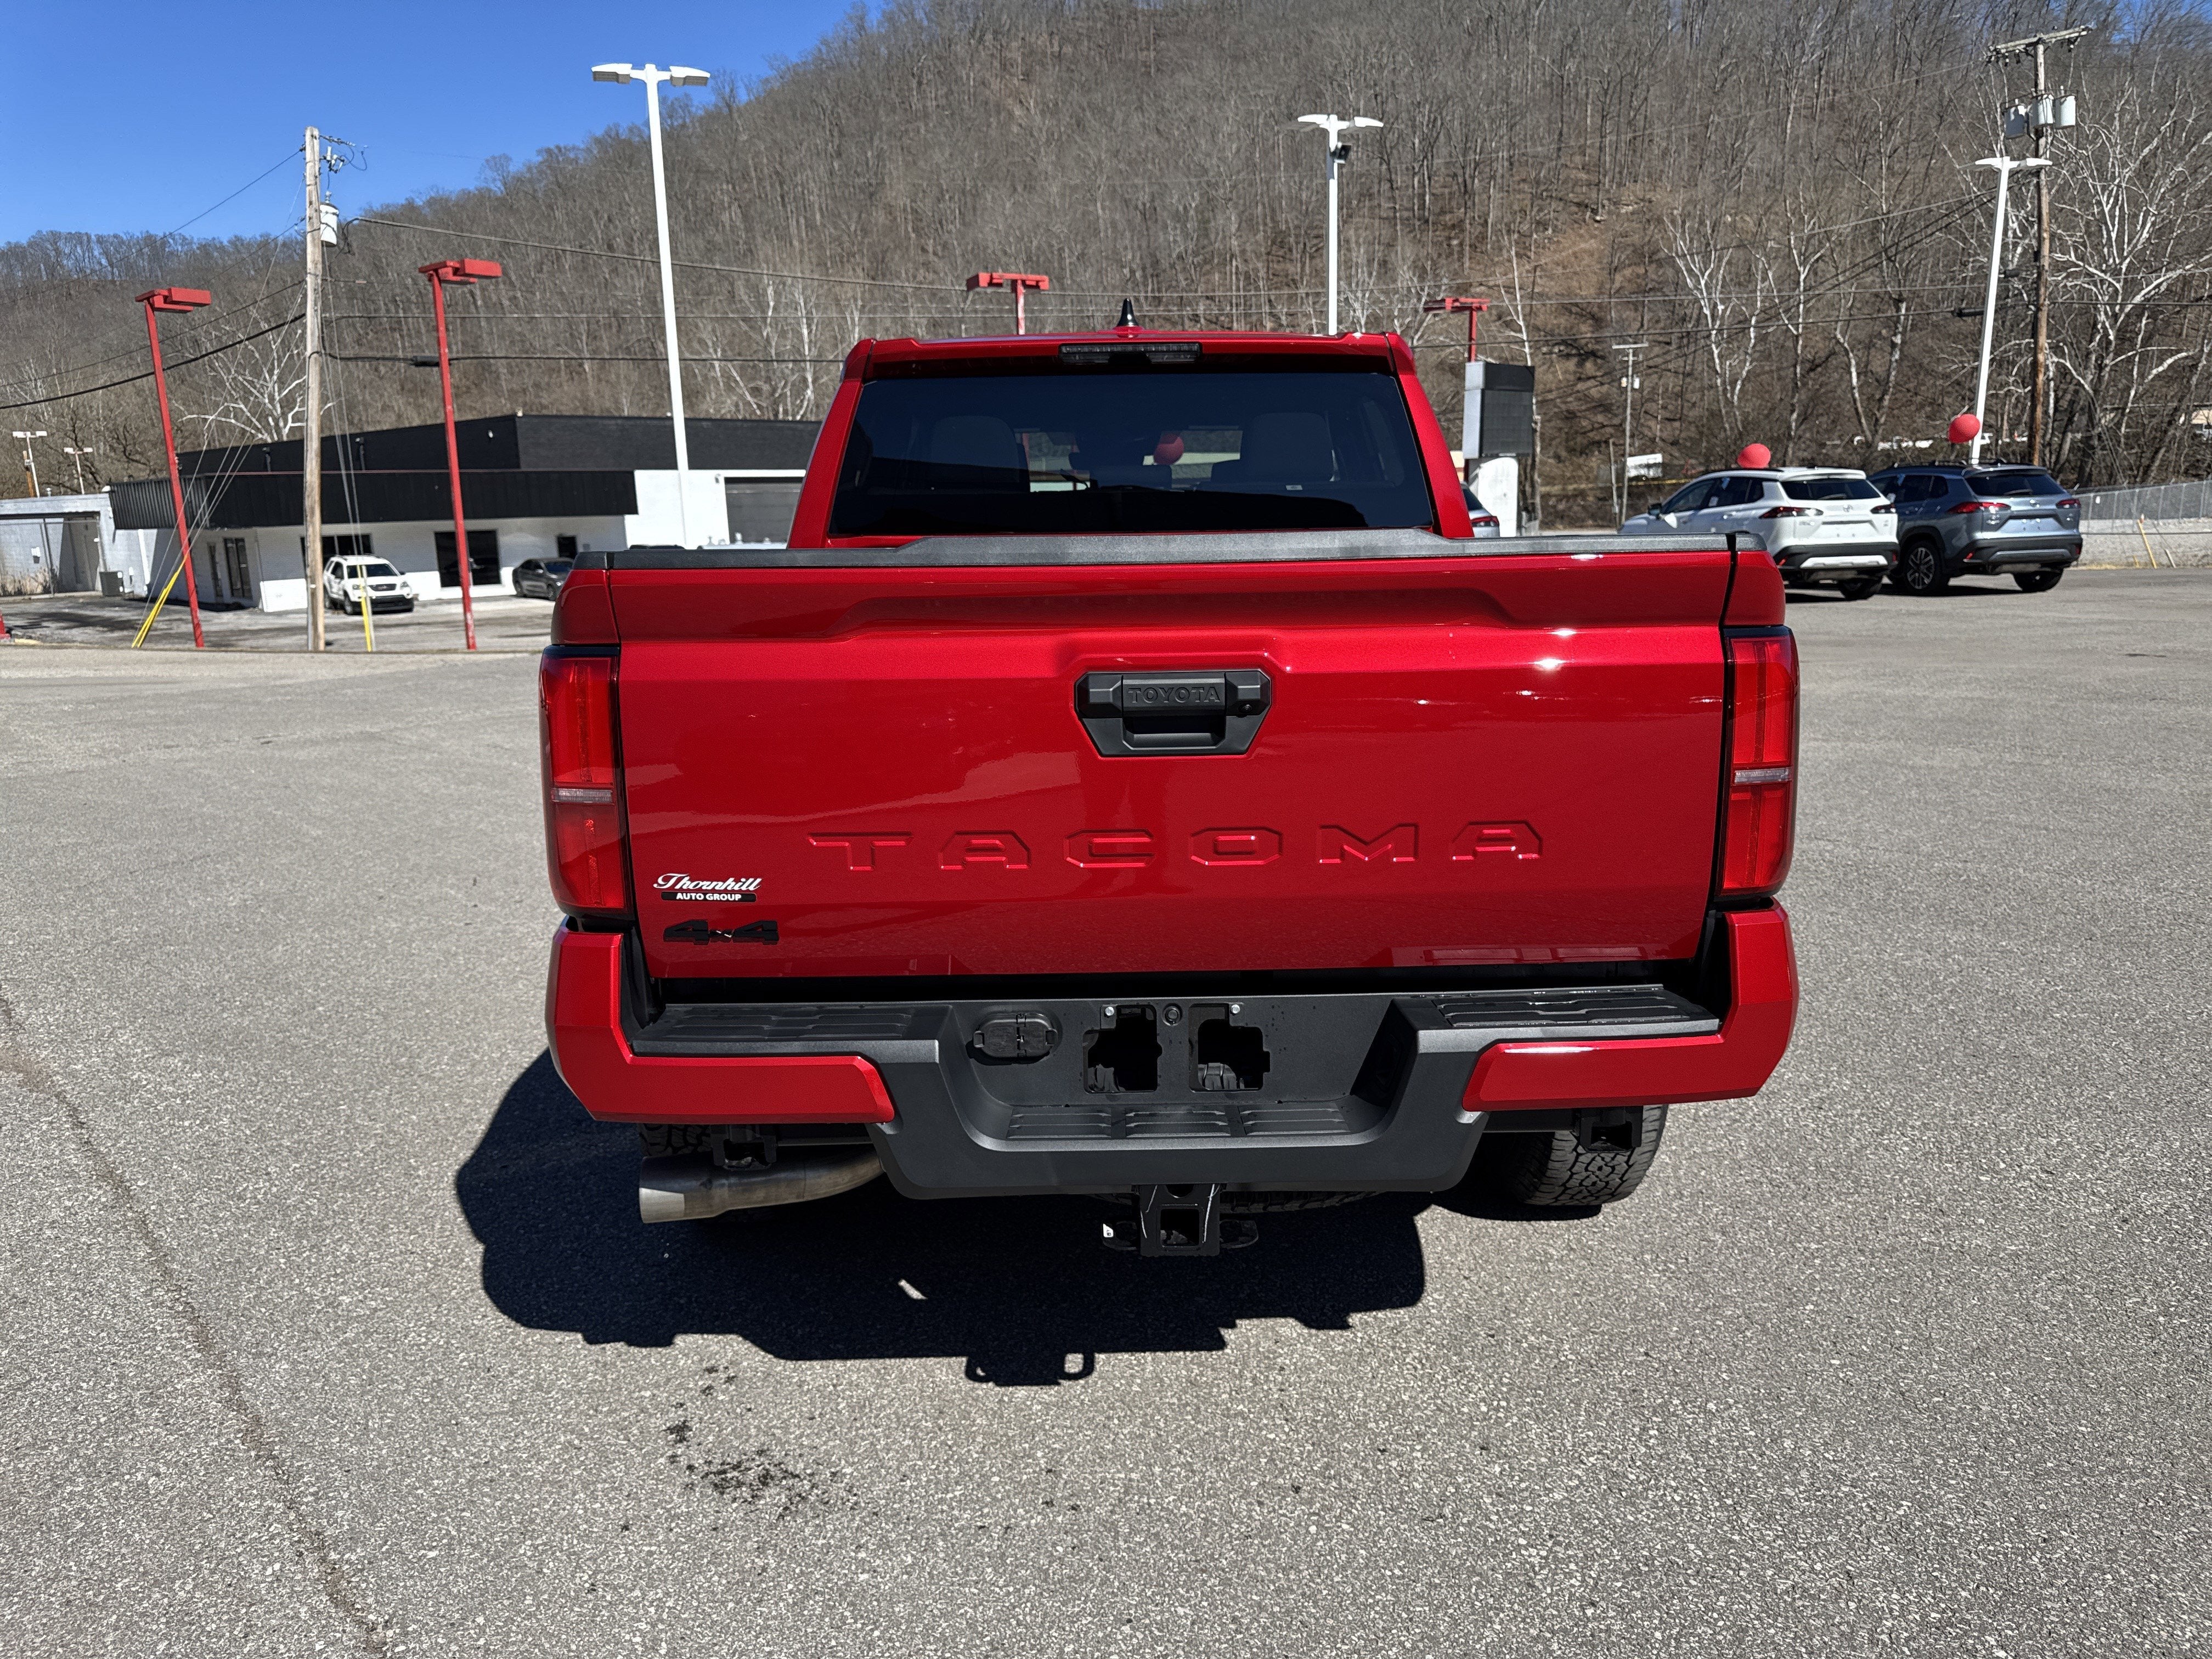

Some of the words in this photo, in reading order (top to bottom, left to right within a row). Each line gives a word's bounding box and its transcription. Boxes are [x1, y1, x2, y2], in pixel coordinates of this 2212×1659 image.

[1127, 686, 1220, 704] TOYOTA
[808, 820, 1543, 872] TACOMA
[653, 873, 763, 891] Thornhill
[706, 893, 742, 901] GROUP
